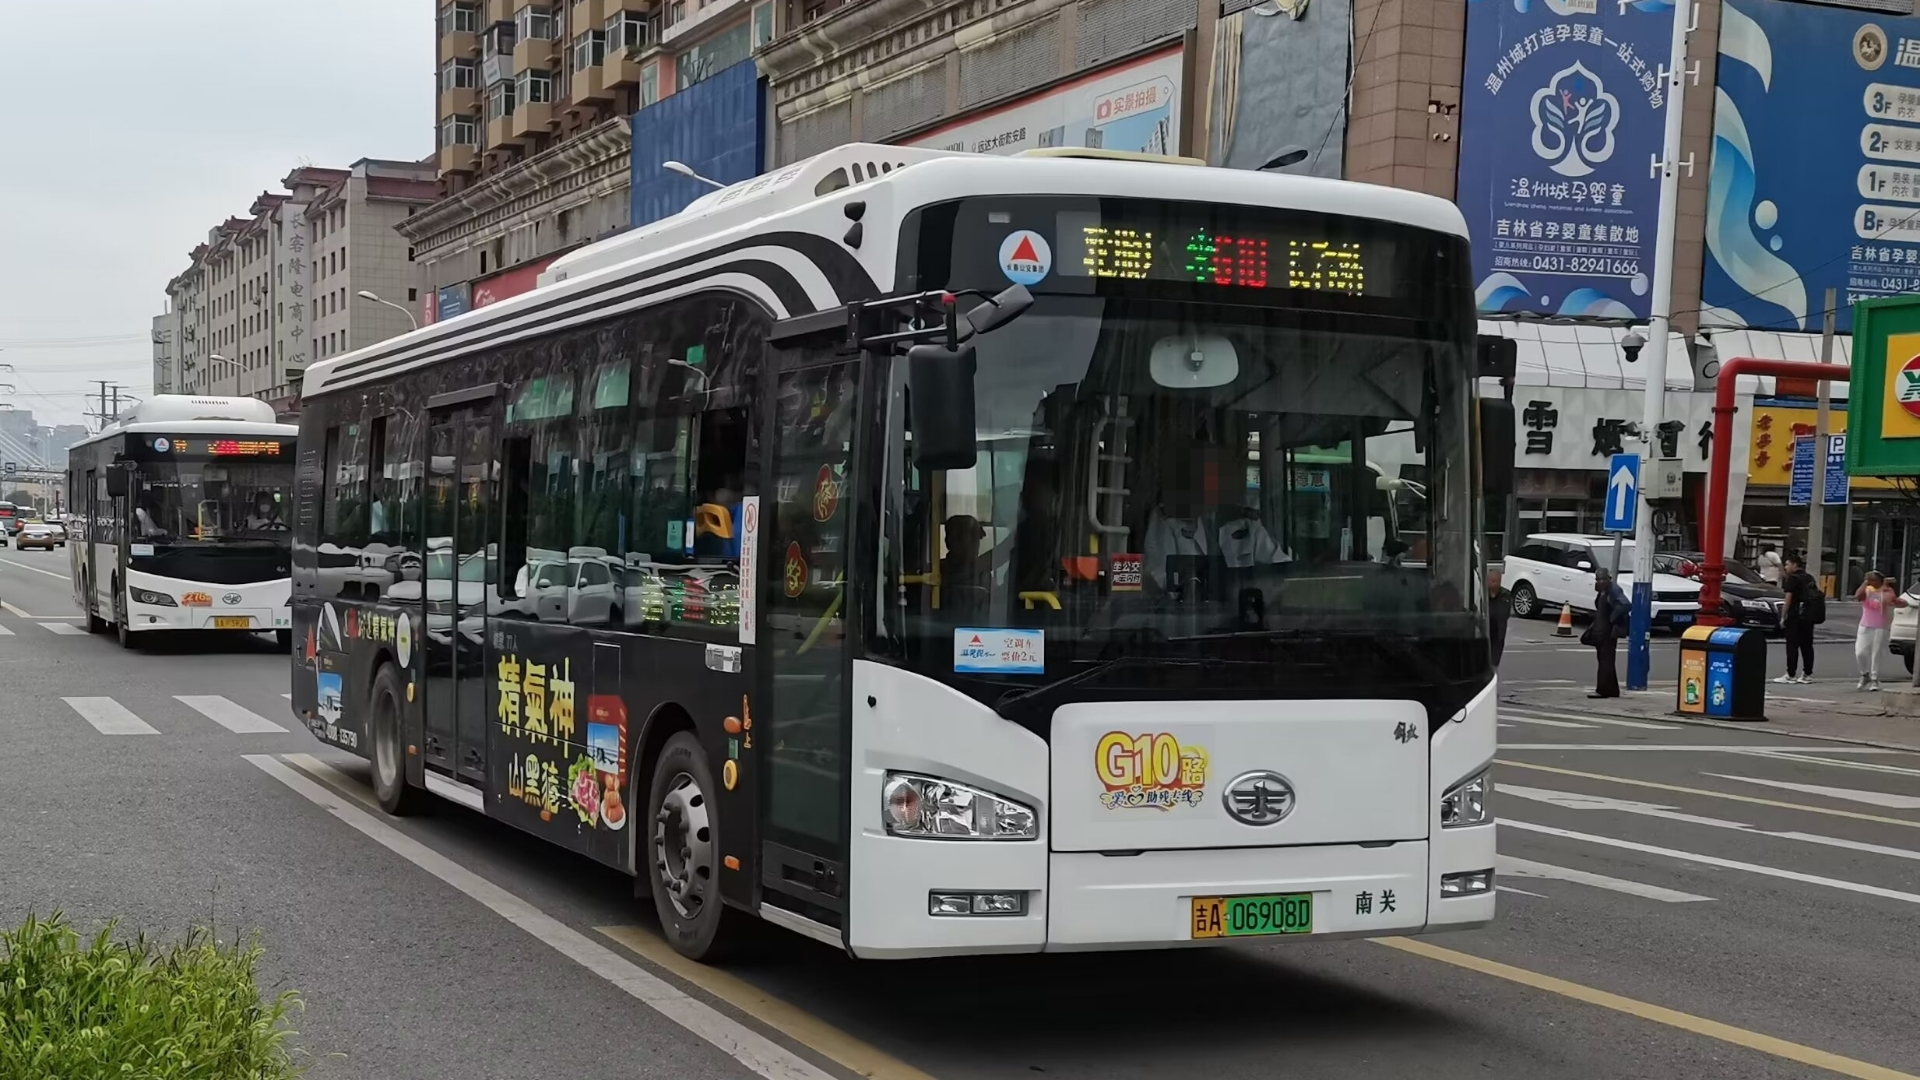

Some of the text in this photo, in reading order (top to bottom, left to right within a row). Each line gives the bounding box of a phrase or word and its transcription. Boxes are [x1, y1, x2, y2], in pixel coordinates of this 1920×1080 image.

[1484, 23, 1664, 110] 温州城打造孕婴童一站式购物
[1112, 84, 1158, 115] 实景拍摄
[1510, 177, 1626, 206] 温州城孕婴童
[1496, 218, 1639, 243] 吉林省孕婴童集散地
[1533, 255, 1639, 275] 0431-82941666
[1095, 731, 1206, 787] G10路
[1355, 889, 1396, 915] 南关
